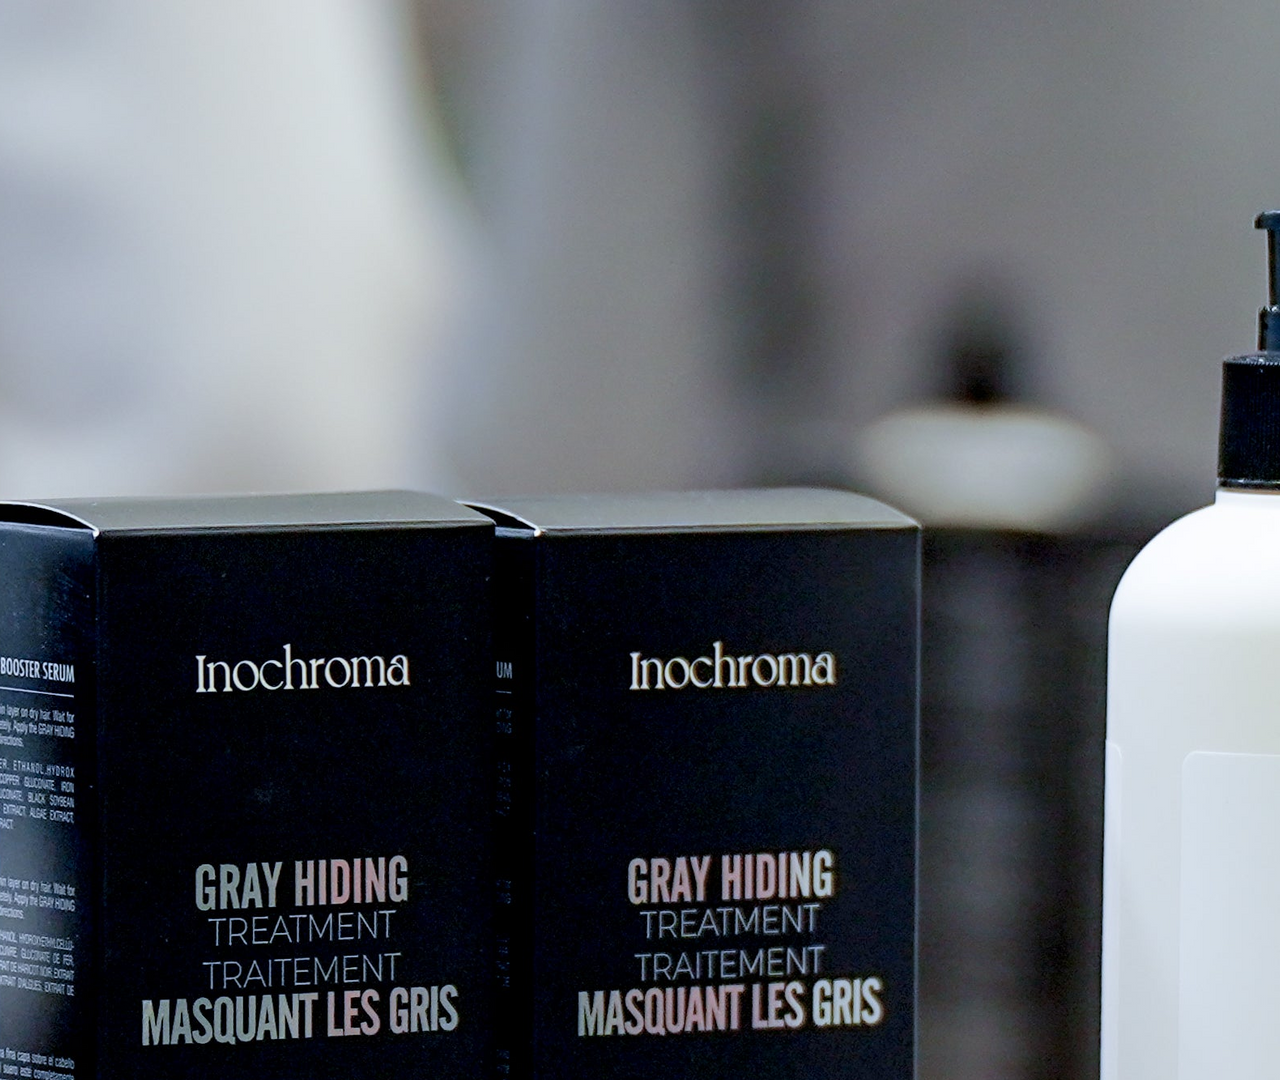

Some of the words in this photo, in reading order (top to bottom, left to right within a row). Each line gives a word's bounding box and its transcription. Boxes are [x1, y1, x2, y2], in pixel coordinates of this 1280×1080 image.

[0, 656, 40, 679] BOOSTER
[42, 661, 75, 683] SERUM
[196, 644, 410, 693] Inochroma
[629, 642, 836, 691] Inochroma
[195, 863, 282, 911] GRAY
[295, 855, 409, 907] HIDING
[627, 857, 711, 905] GRAY
[722, 850, 833, 901] HIDING
[208, 910, 397, 946] TREATMENT
[640, 904, 822, 940] TREATMENT
[203, 952, 402, 990] TRAITEMENT
[634, 945, 824, 983] TRAITEMENT
[142, 993, 318, 1046] MASQUANT
[327, 989, 381, 1037] LES
[389, 985, 459, 1033] GRIS
[577, 984, 741, 1037] MASQUANT
[752, 981, 802, 1029] LES
[812, 978, 883, 1025] GRIS
